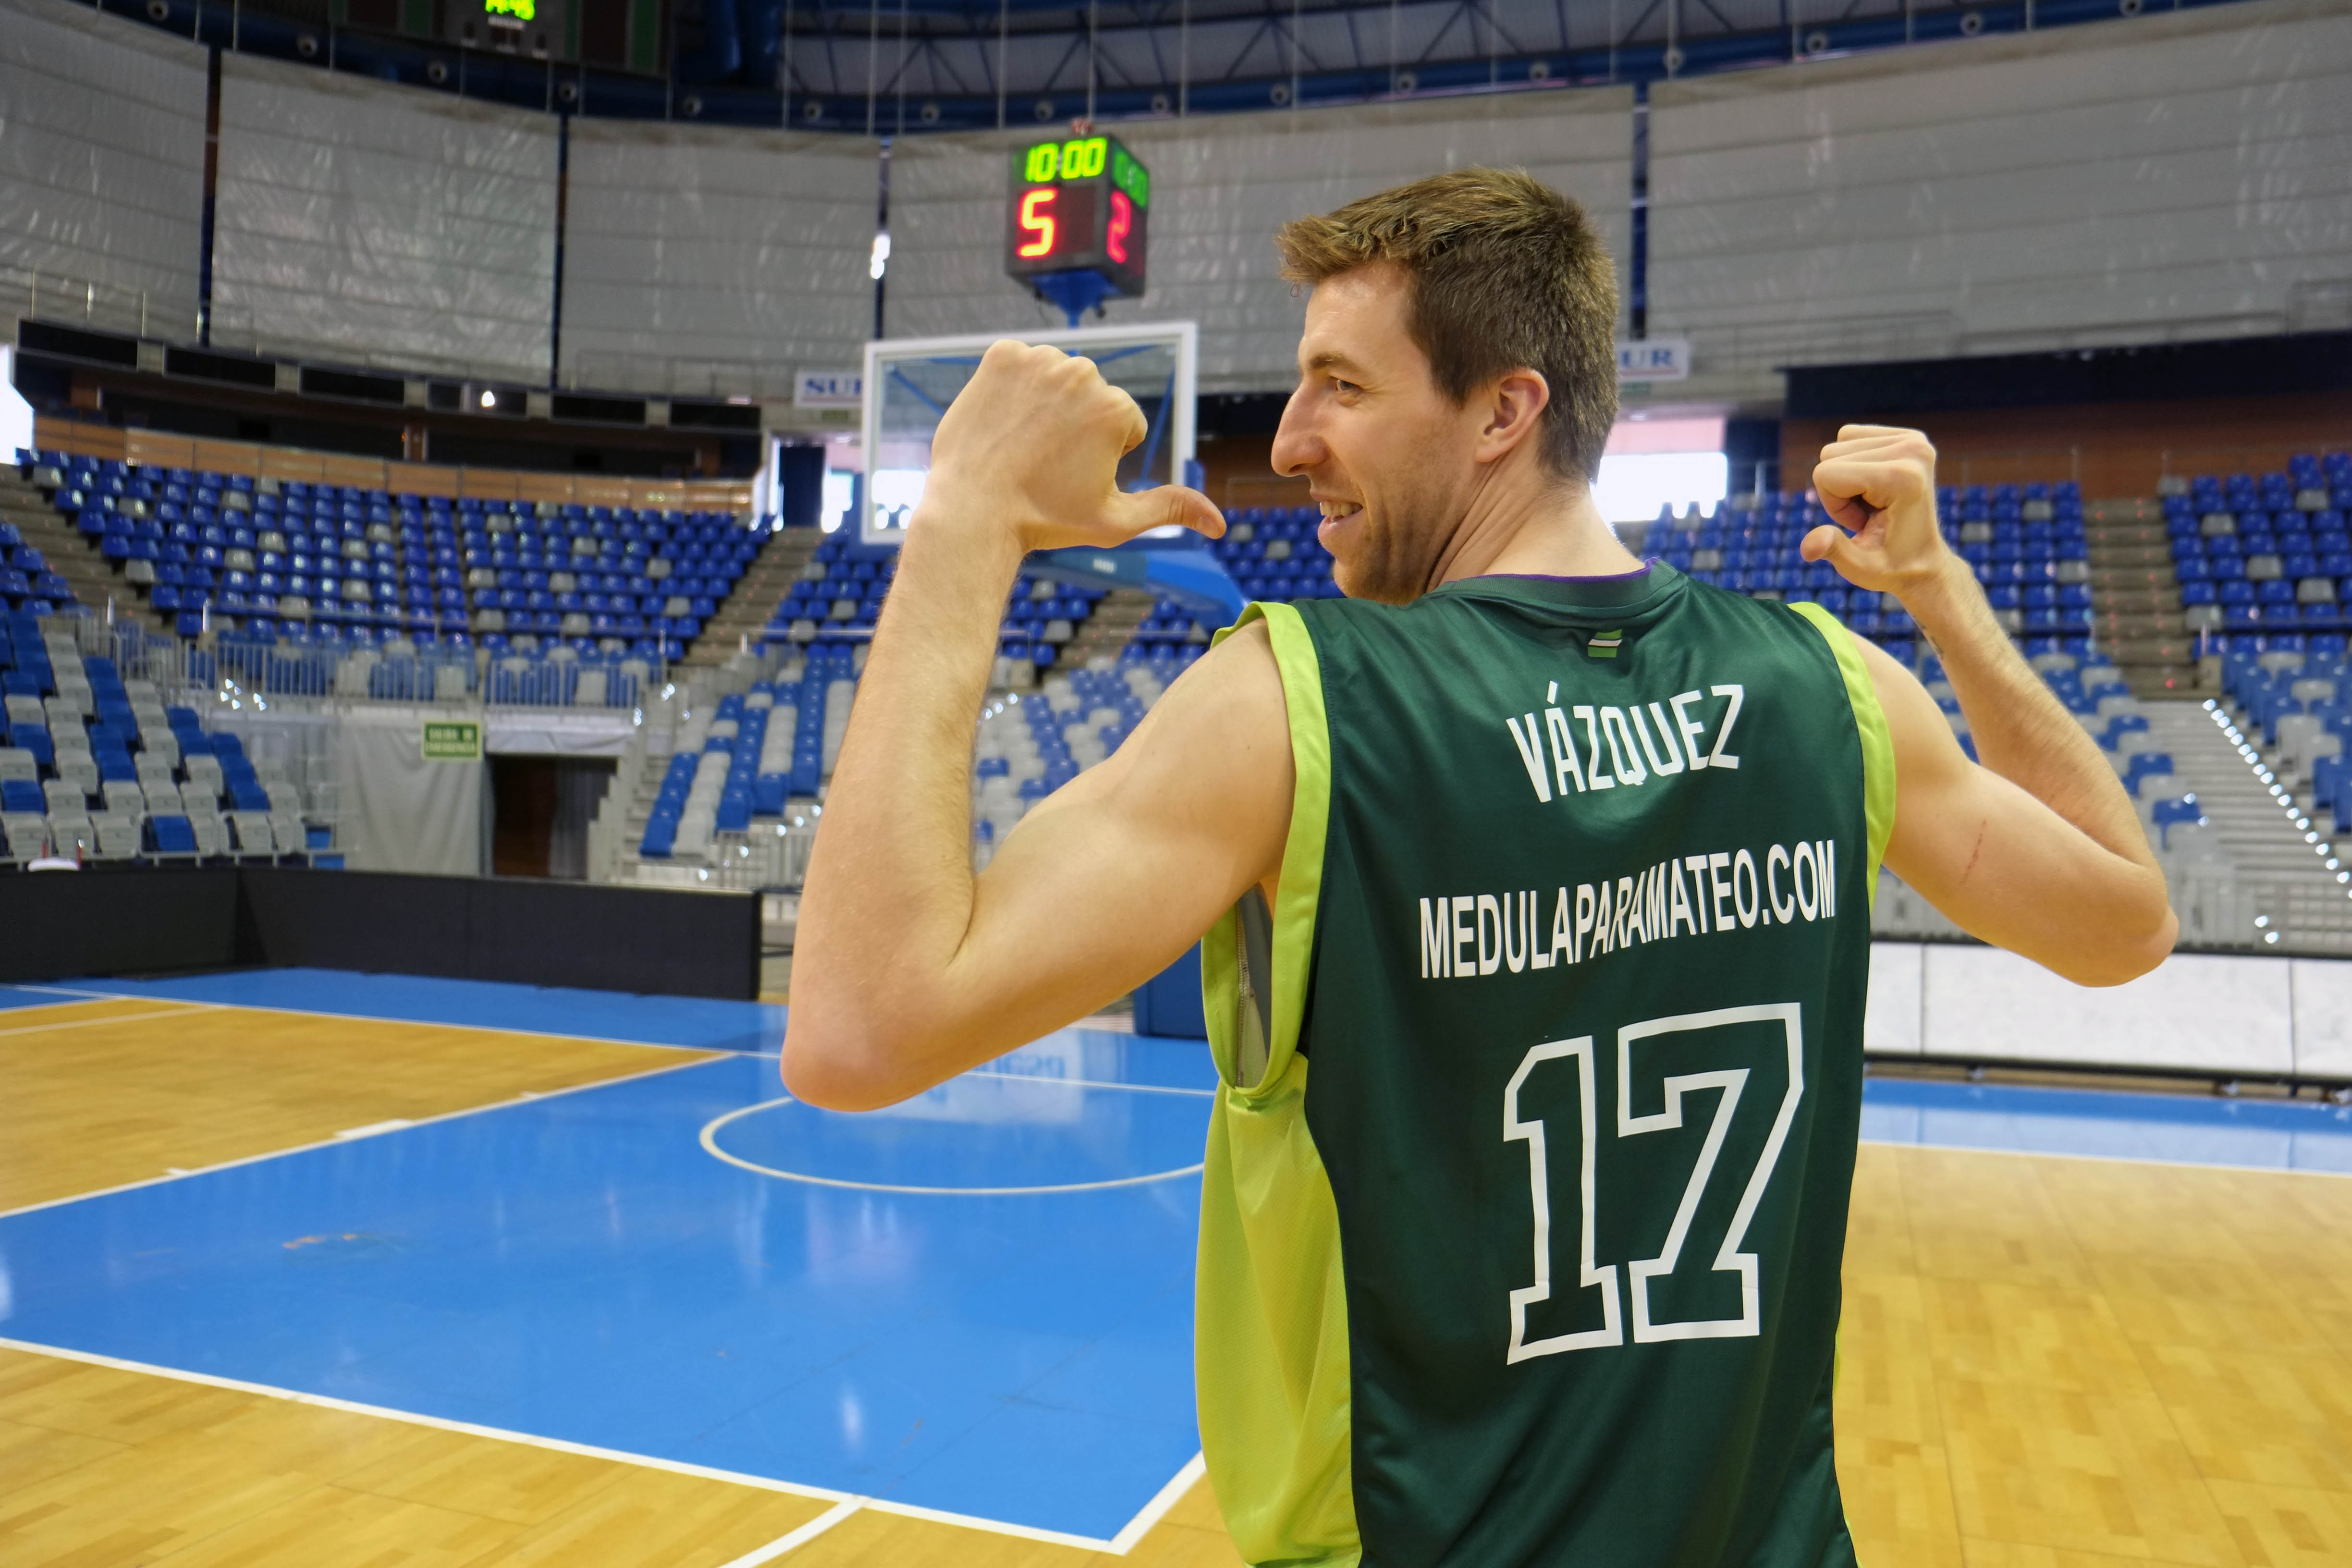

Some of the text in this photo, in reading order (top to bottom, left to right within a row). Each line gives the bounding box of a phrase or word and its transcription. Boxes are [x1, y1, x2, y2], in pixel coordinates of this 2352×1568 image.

[1017, 188, 1057, 258] 5
[1107, 190, 1131, 263] 2
[1619, 349, 1673, 367] UR
[1506, 680, 1744, 803] VÁZQUEZ
[1420, 840, 1835, 978] MEDULAPARAMATEO.COM
[1503, 1002, 1804, 1365] 17
